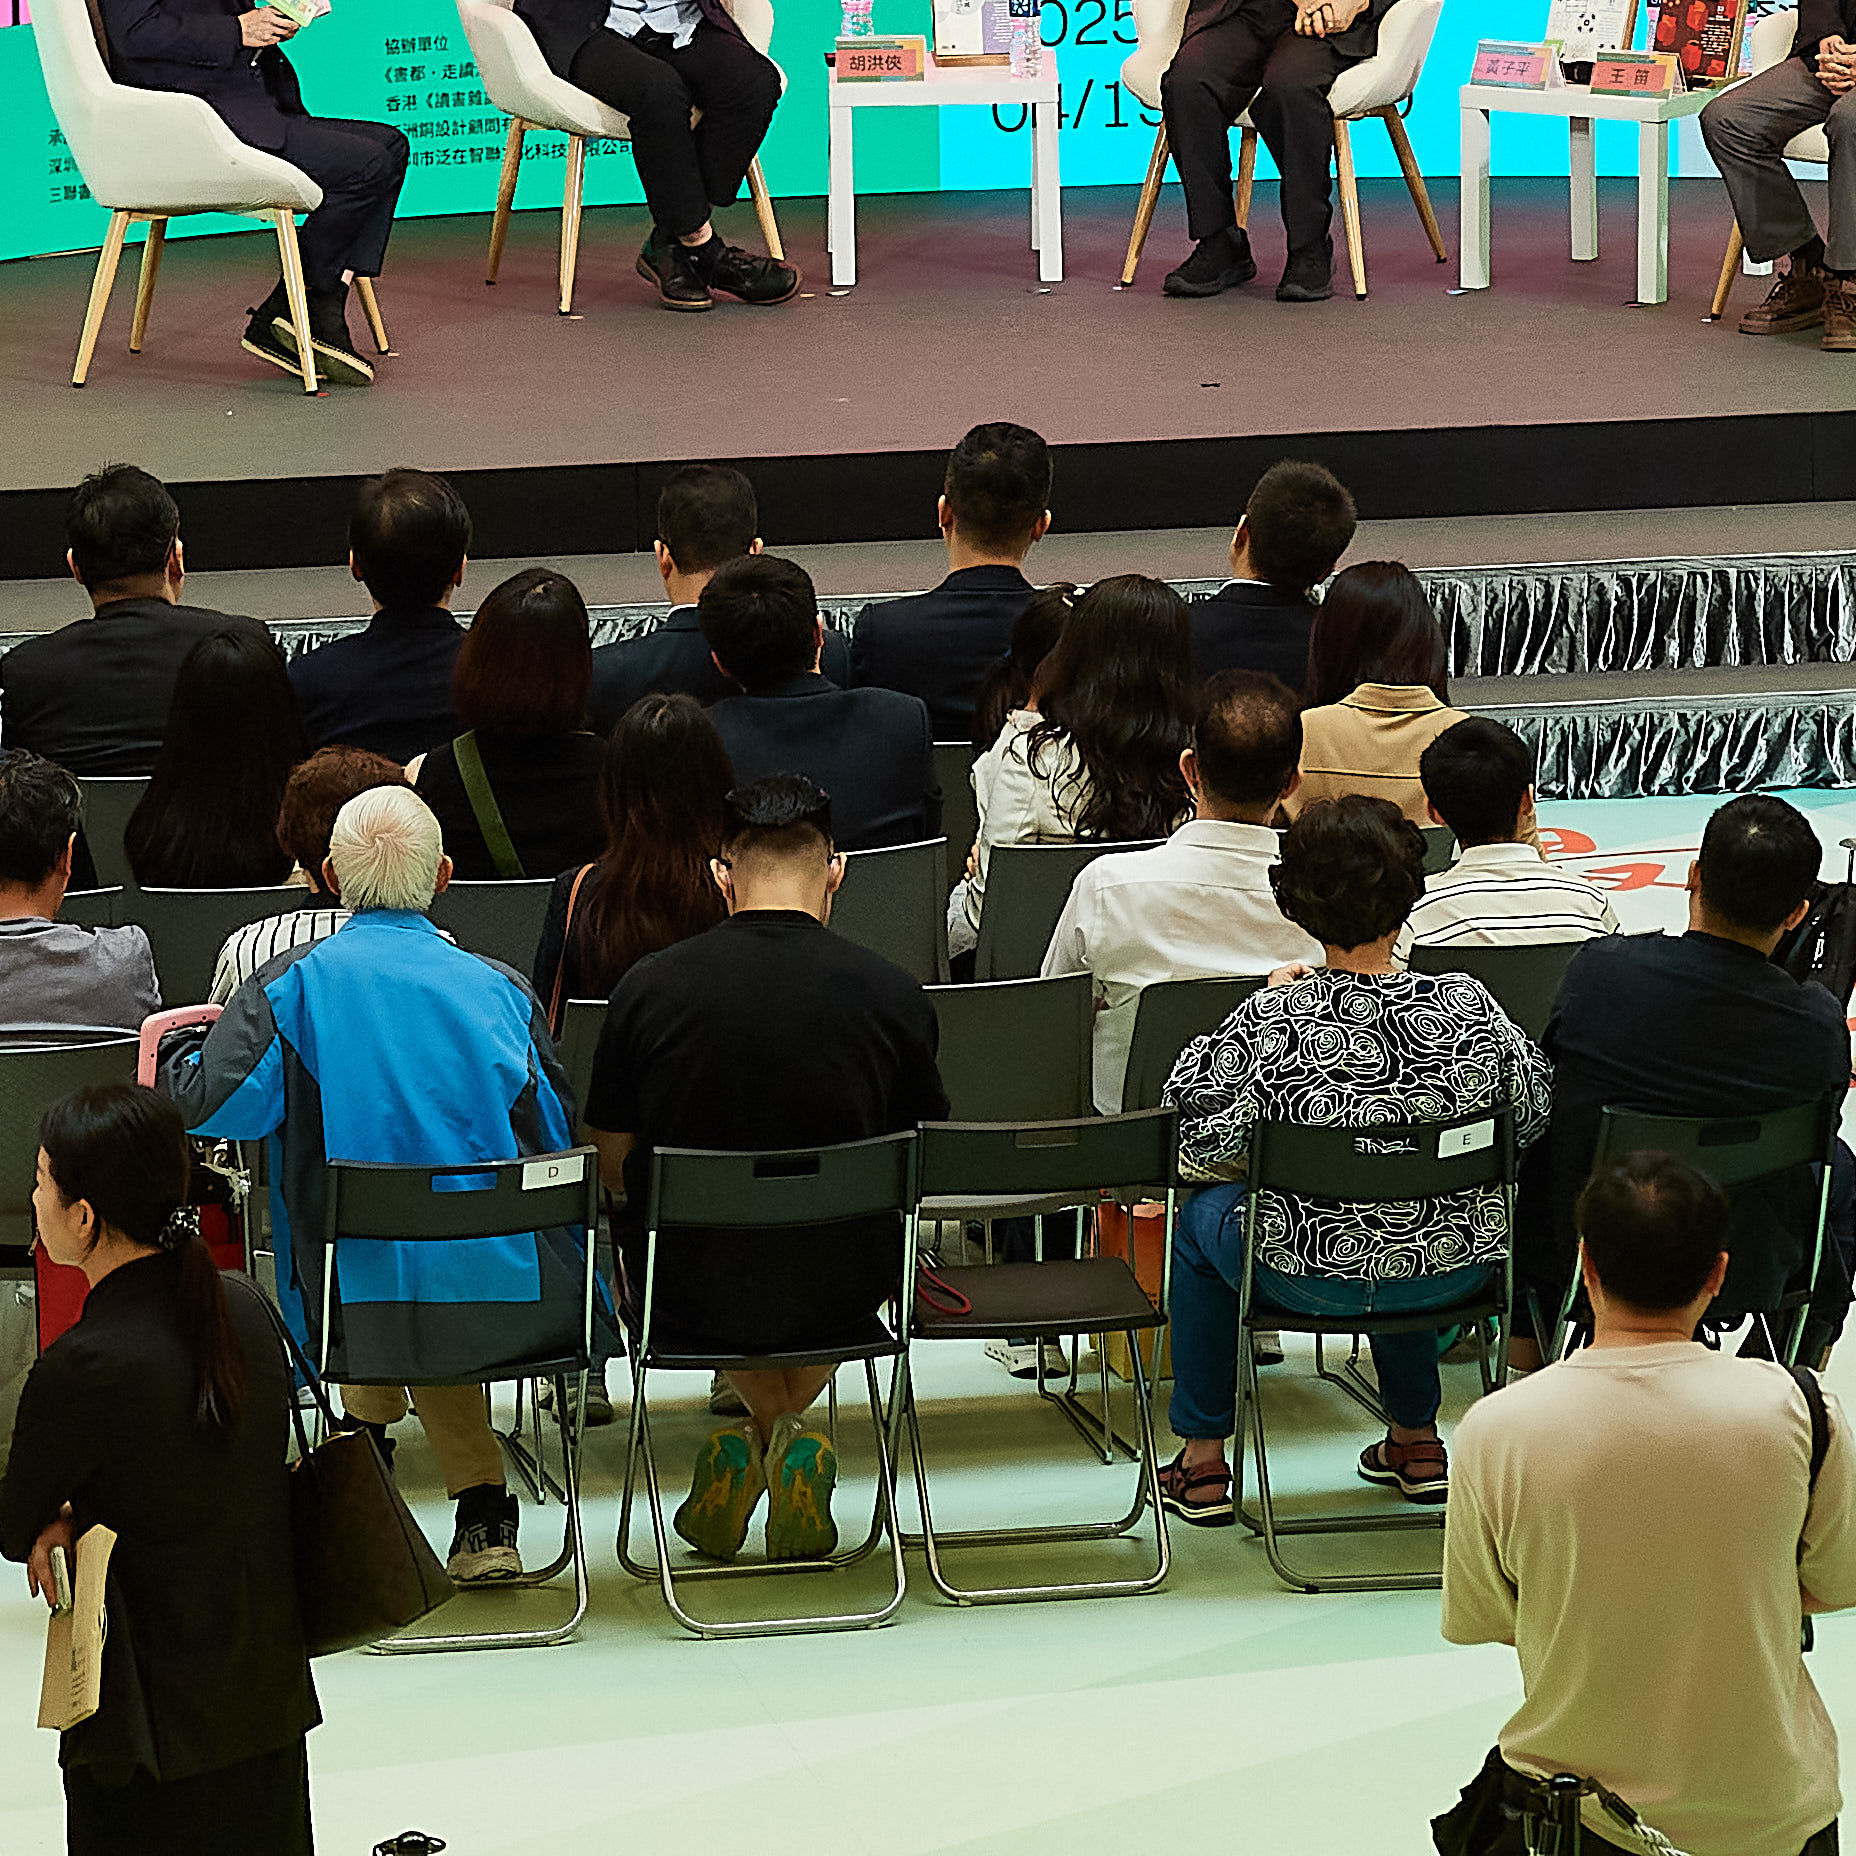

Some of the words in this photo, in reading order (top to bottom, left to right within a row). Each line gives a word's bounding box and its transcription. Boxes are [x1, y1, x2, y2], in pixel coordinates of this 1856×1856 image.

[48, 129, 67, 147] 承
[1462, 1133, 1472, 1145] E
[547, 1166, 559, 1179] D
